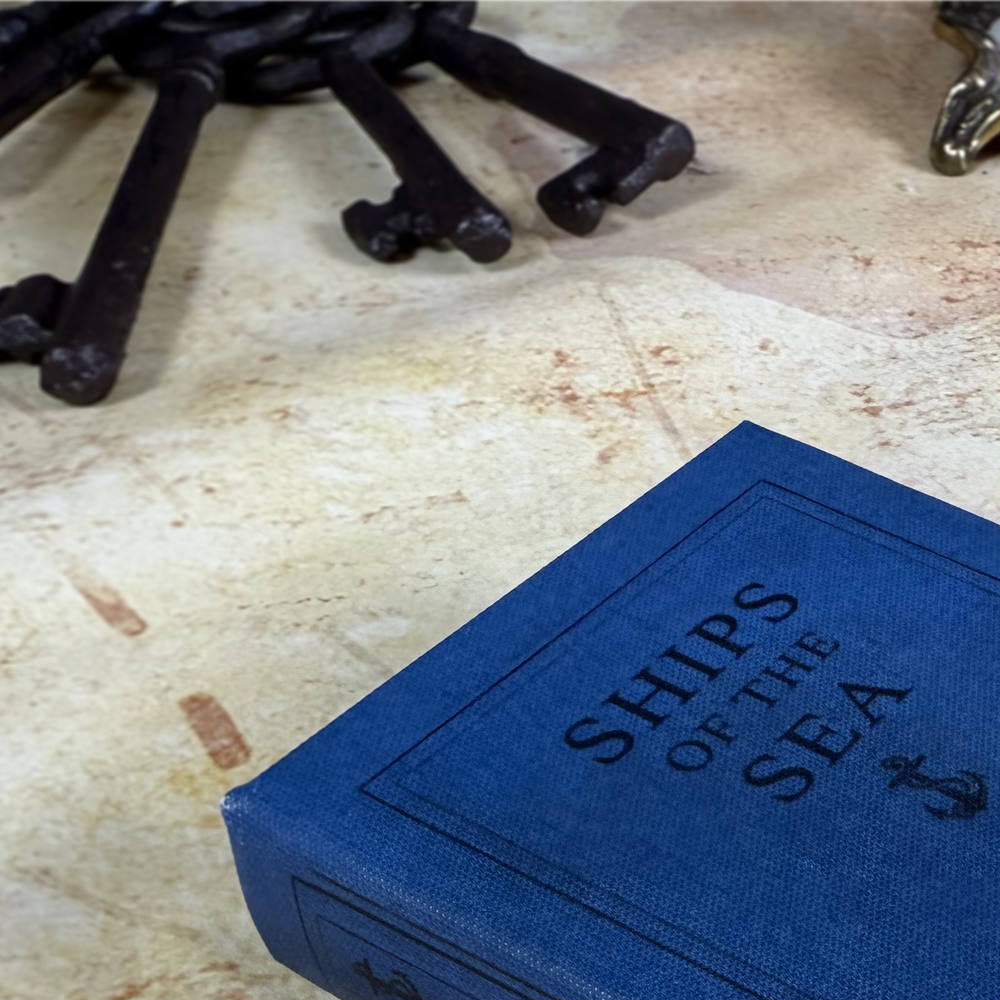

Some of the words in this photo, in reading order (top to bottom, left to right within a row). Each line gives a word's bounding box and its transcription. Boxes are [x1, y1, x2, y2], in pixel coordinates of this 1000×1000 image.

[563, 582, 799, 764] SHIPS
[666, 713, 736, 772] OF
[729, 631, 841, 708] THE
[743, 681, 913, 802] SEA
